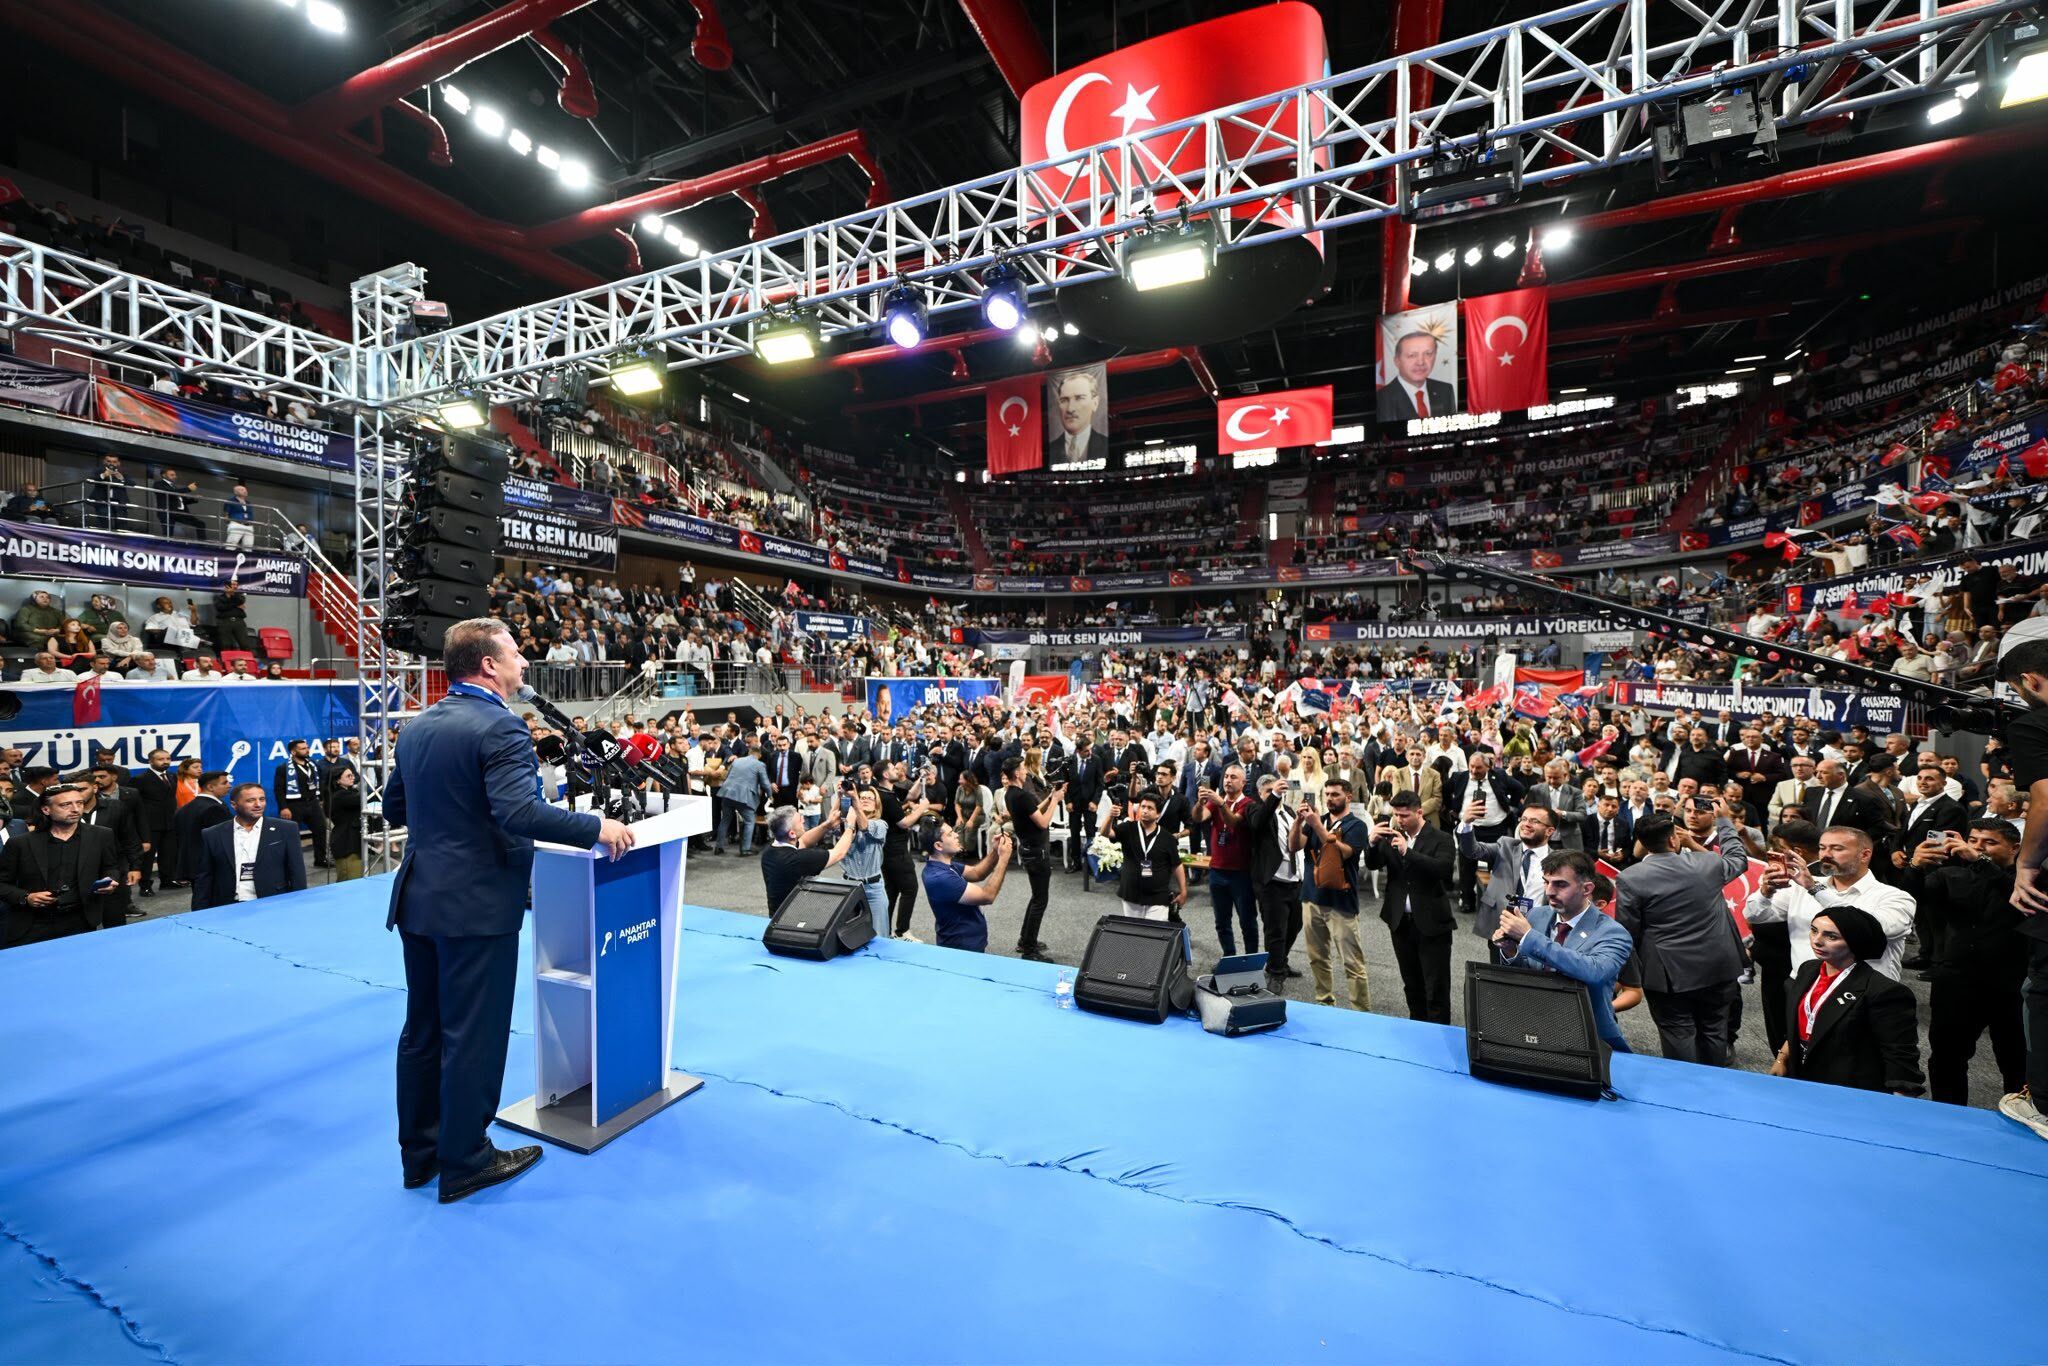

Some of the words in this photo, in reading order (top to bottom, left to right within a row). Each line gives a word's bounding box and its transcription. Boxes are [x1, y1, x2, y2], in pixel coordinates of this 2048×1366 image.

[1874, 326, 1914, 350] DUALI
[1915, 302, 1978, 336] ANALARIN
[231, 413, 329, 446] ÖZGÜRLÜĞÜN
[238, 427, 270, 444] SON
[273, 435, 324, 455] UMUDU
[522, 489, 553, 503] UMUDU
[517, 509, 544, 522] YAVUZ
[546, 514, 578, 528] BAŞKAN
[648, 513, 687, 530] MEMURUN
[687, 523, 714, 537] UMUDU
[501, 518, 533, 542] TEK
[535, 524, 566, 547] SEN
[568, 530, 617, 555] KALDIN
[504, 539, 535, 552] TABUTA
[537, 544, 589, 560] SIĞMAYANLAR
[791, 547, 811, 559] UMUDU
[123, 551, 161, 571] SON
[163, 556, 219, 578] KALESİ
[255, 558, 301, 575] ANAHTAR
[265, 571, 292, 585] PARTİ
[1029, 631, 1048, 645] BİR
[1050, 633, 1072, 645] TEK
[1074, 632, 1095, 645] SEN
[1098, 631, 1142, 645] KALDIN
[1357, 623, 1384, 639] DİLİ
[1386, 624, 1430, 639] DUALI
[1432, 621, 1511, 638] ANALARIN
[1515, 618, 1540, 636] ALİ
[1544, 616, 1611, 635] YÜREKLİ
[924, 684, 942, 706] BİR
[943, 687, 959, 705] TEK
[1696, 692, 1708, 710] BU
[1742, 695, 1806, 718] BORCUMUZ
[1860, 696, 1901, 710] ANAHTAR
[1866, 708, 1893, 722] PARTİ
[12, 728, 192, 772] ZÜMÜZ
[619, 918, 657, 939] ANAHTAR
[627, 929, 649, 945] PARTİ
